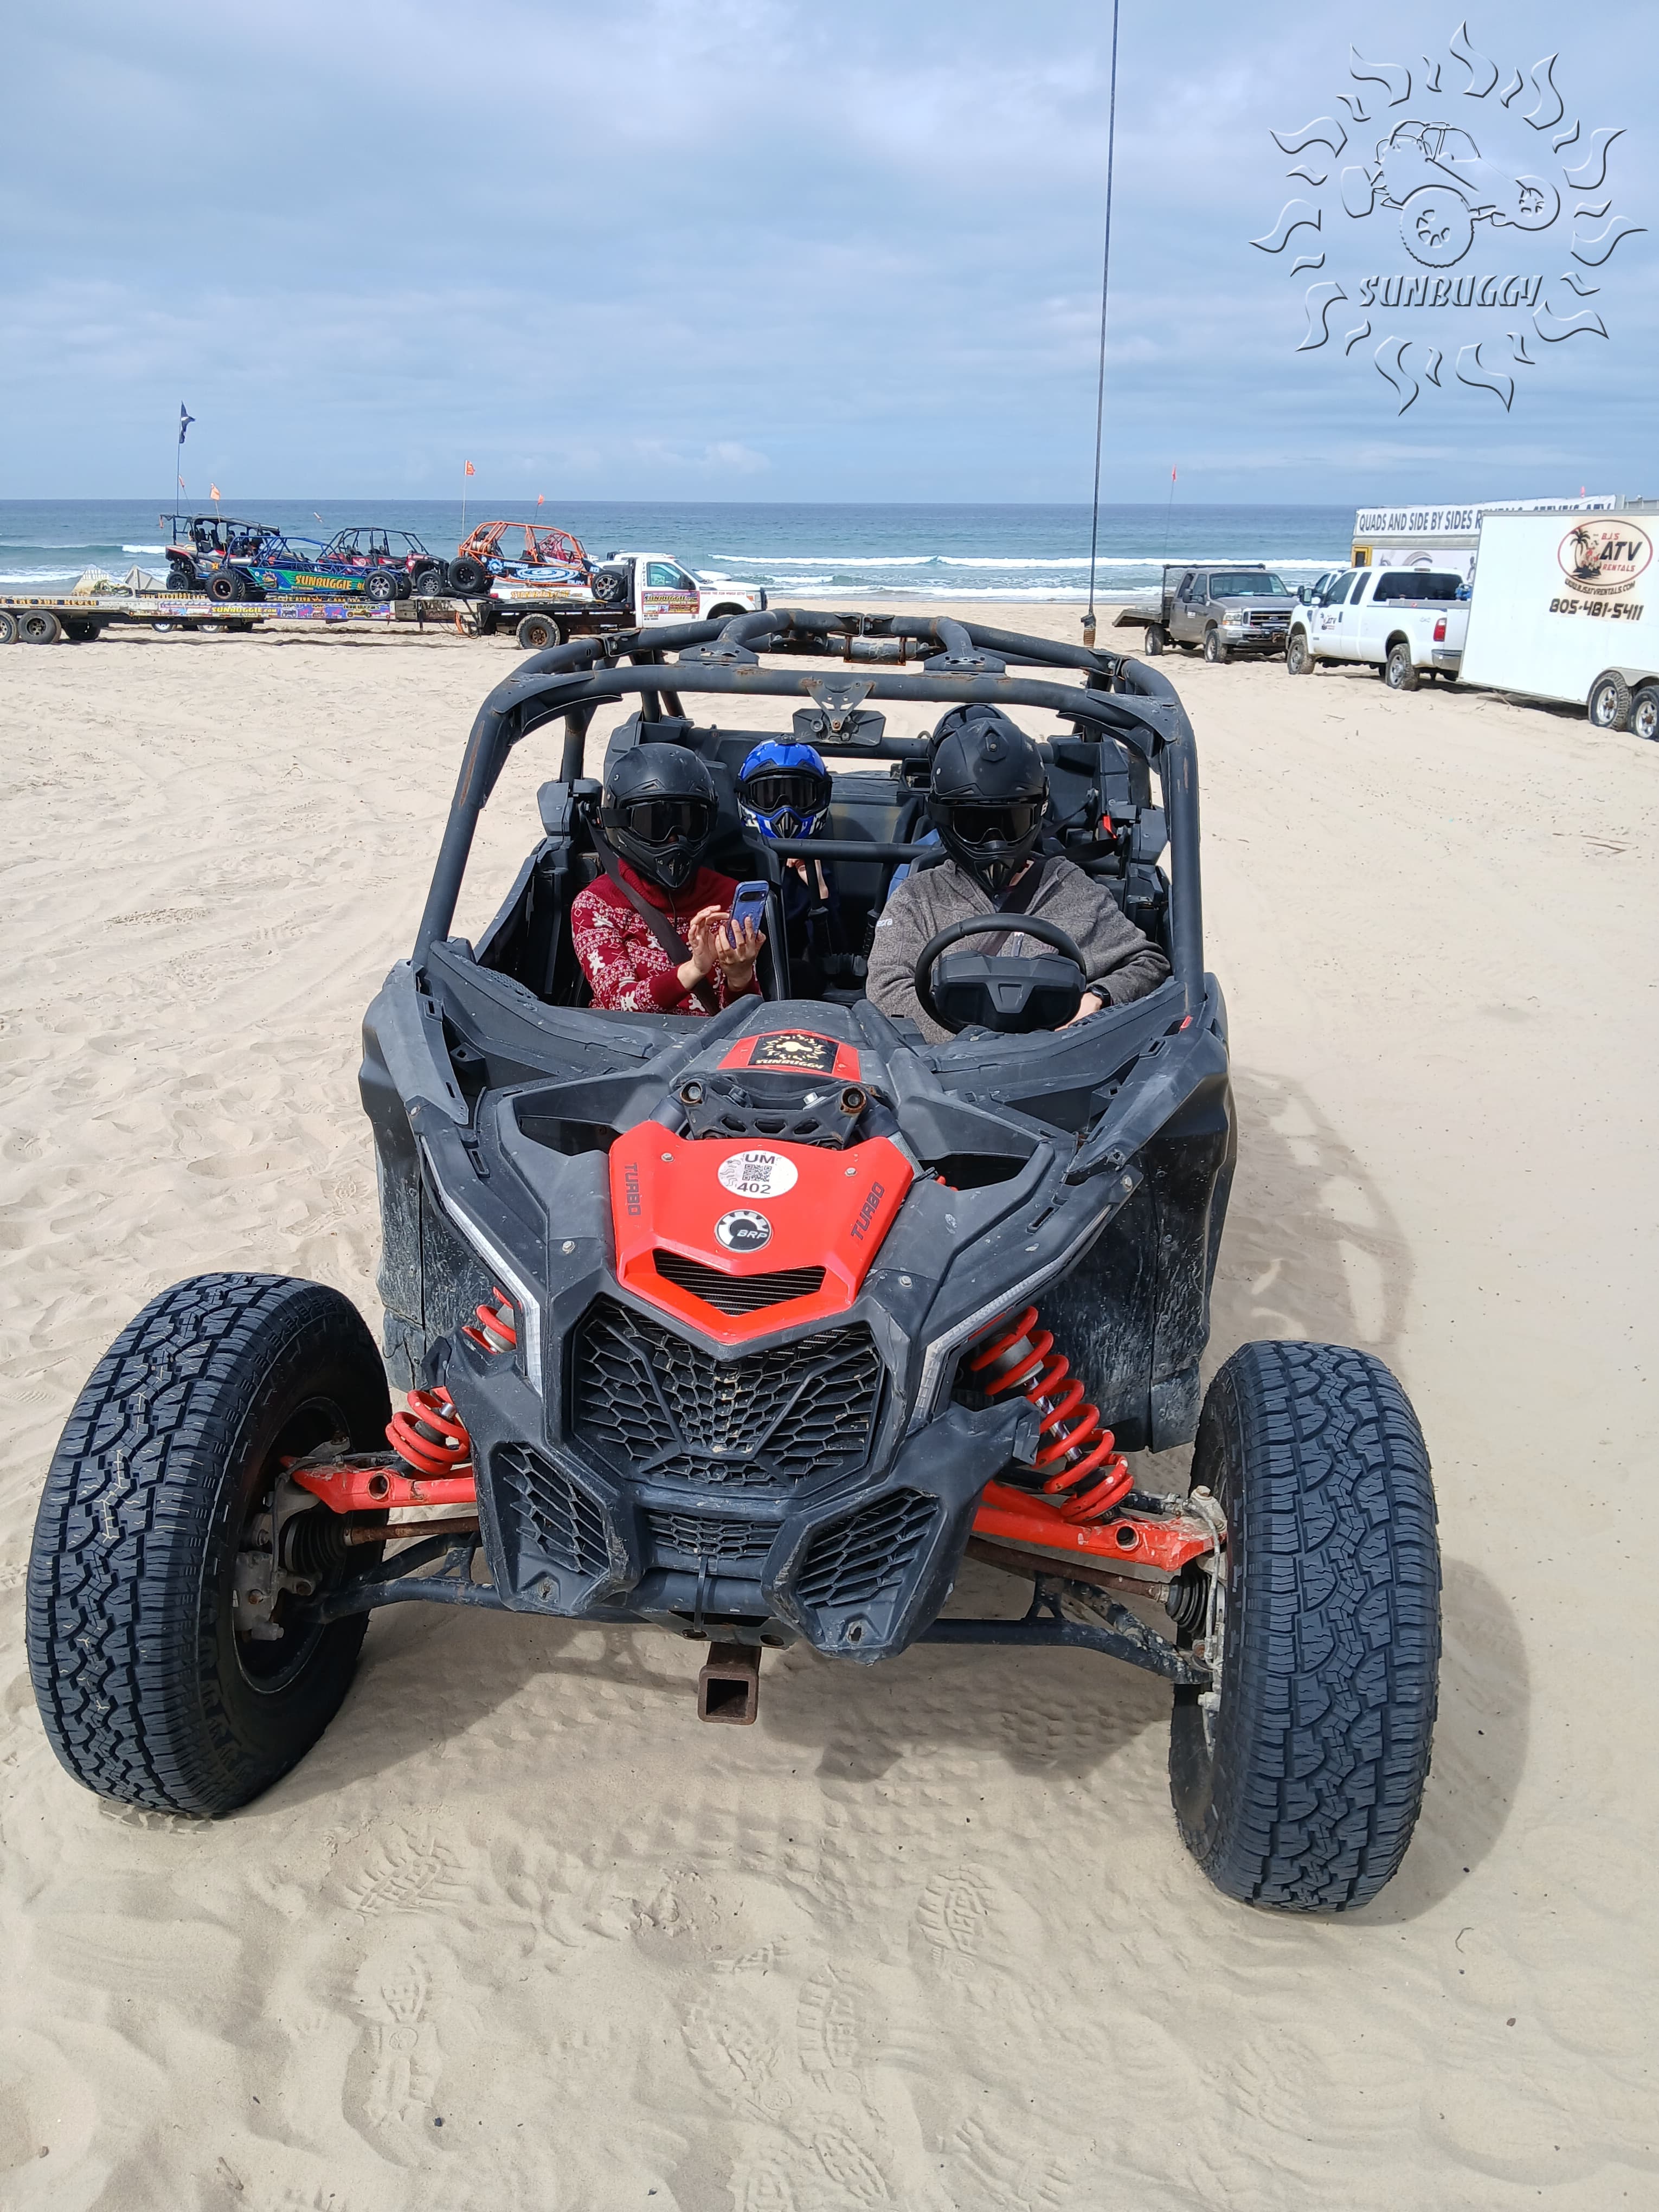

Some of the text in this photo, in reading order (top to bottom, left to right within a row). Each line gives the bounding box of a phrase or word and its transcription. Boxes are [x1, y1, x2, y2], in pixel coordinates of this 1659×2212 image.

[1359, 513, 1387, 532] QUADS
[1387, 513, 1407, 531] AND
[1409, 512, 1428, 531] SIDE
[1430, 511, 1443, 530] BY
[1444, 510, 1473, 530] SIDES
[1599, 541, 1643, 561] ATV
[1603, 563, 1636, 572] RENTALS
[295, 575, 352, 590] SUNBUGGIE
[1549, 598, 1644, 621] 805-481-5411
[755, 1059, 825, 1069] SUNBUGGY
[745, 1153, 775, 1164] UM
[624, 1162, 641, 1216] TURBO
[737, 1182, 771, 1194] 402
[851, 1181, 885, 1240] TURBO
[737, 1229, 768, 1239] BRP
